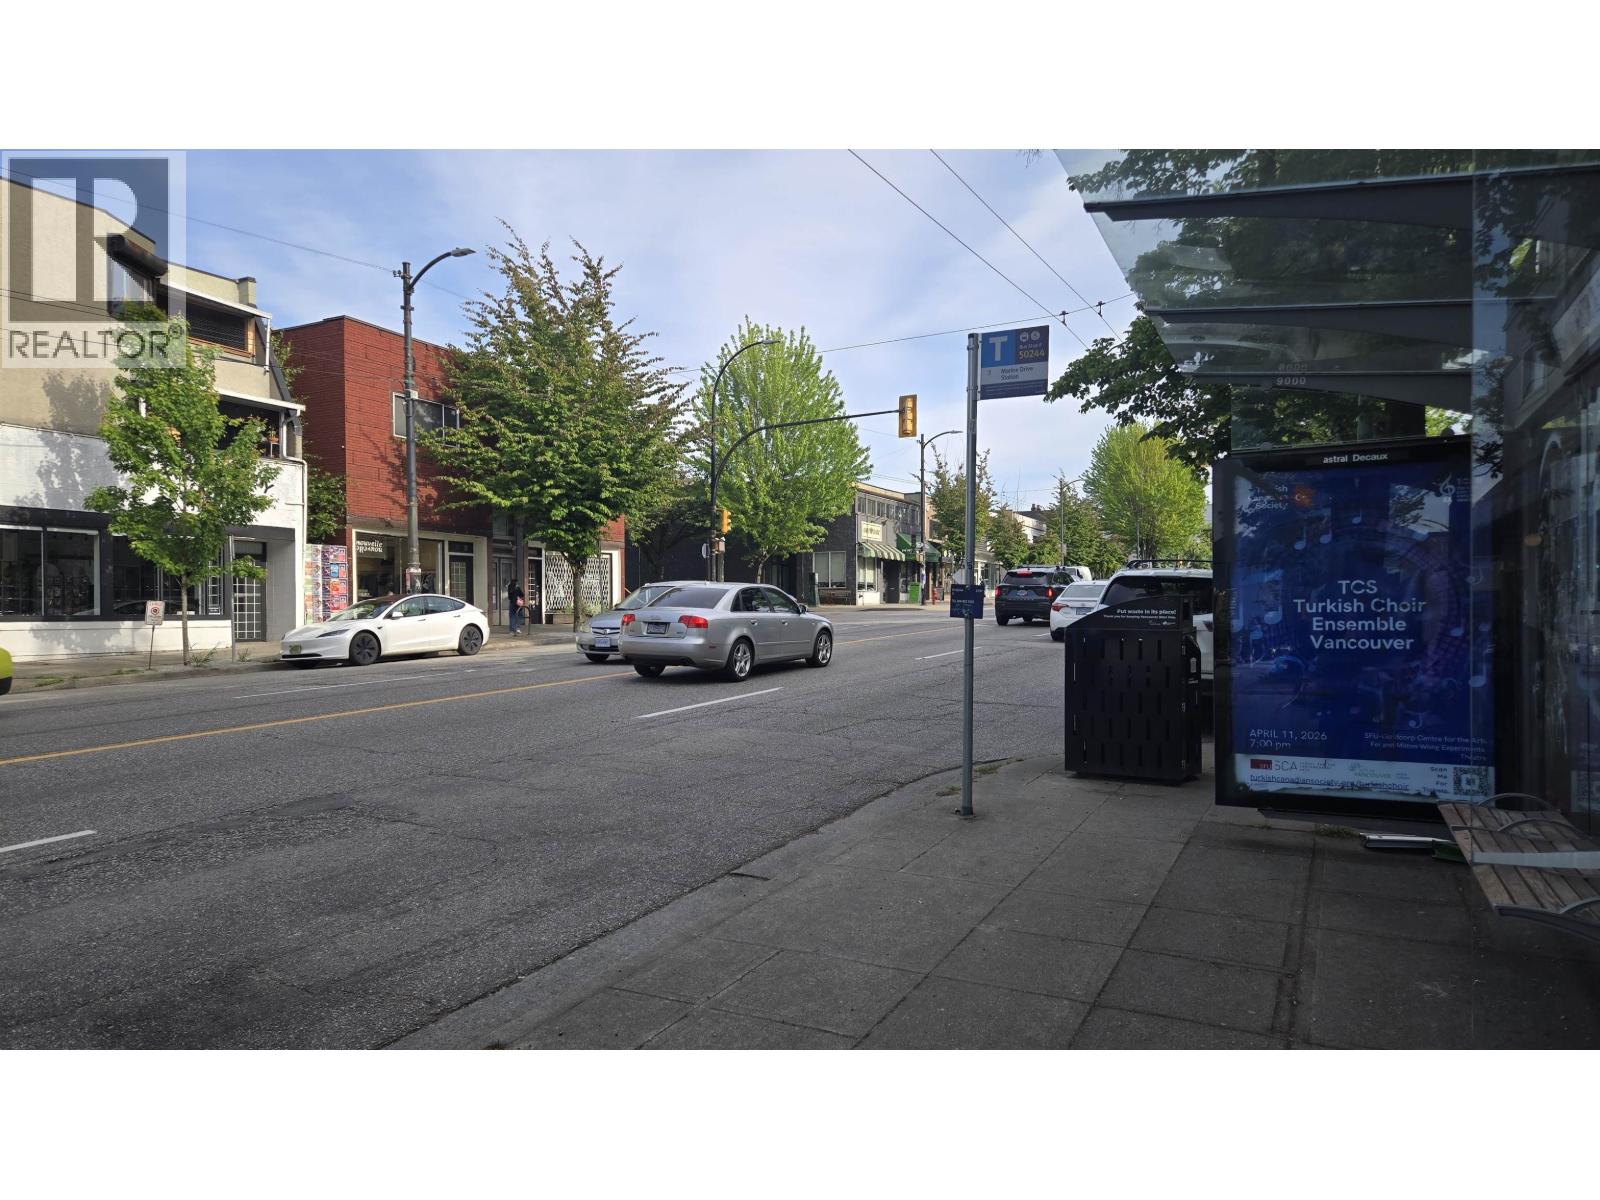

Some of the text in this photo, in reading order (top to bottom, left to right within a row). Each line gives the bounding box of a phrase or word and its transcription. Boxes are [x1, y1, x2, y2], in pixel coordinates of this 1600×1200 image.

[989, 335, 1008, 361] T
[1019, 349, 1045, 359] 50244
[1323, 453, 1388, 463] astral Decaux
[356, 540, 383, 548] nouvelle
[1338, 580, 1378, 594] TCS
[1293, 597, 1426, 612] Turkish Choir
[1312, 616, 1407, 631] Ensemble
[1310, 634, 1414, 650] Vancouver
[1250, 730, 1327, 740] APRIL 11, 2026
[1250, 739, 1291, 750] 7:00 pm
[1275, 761, 1298, 771] SCA
